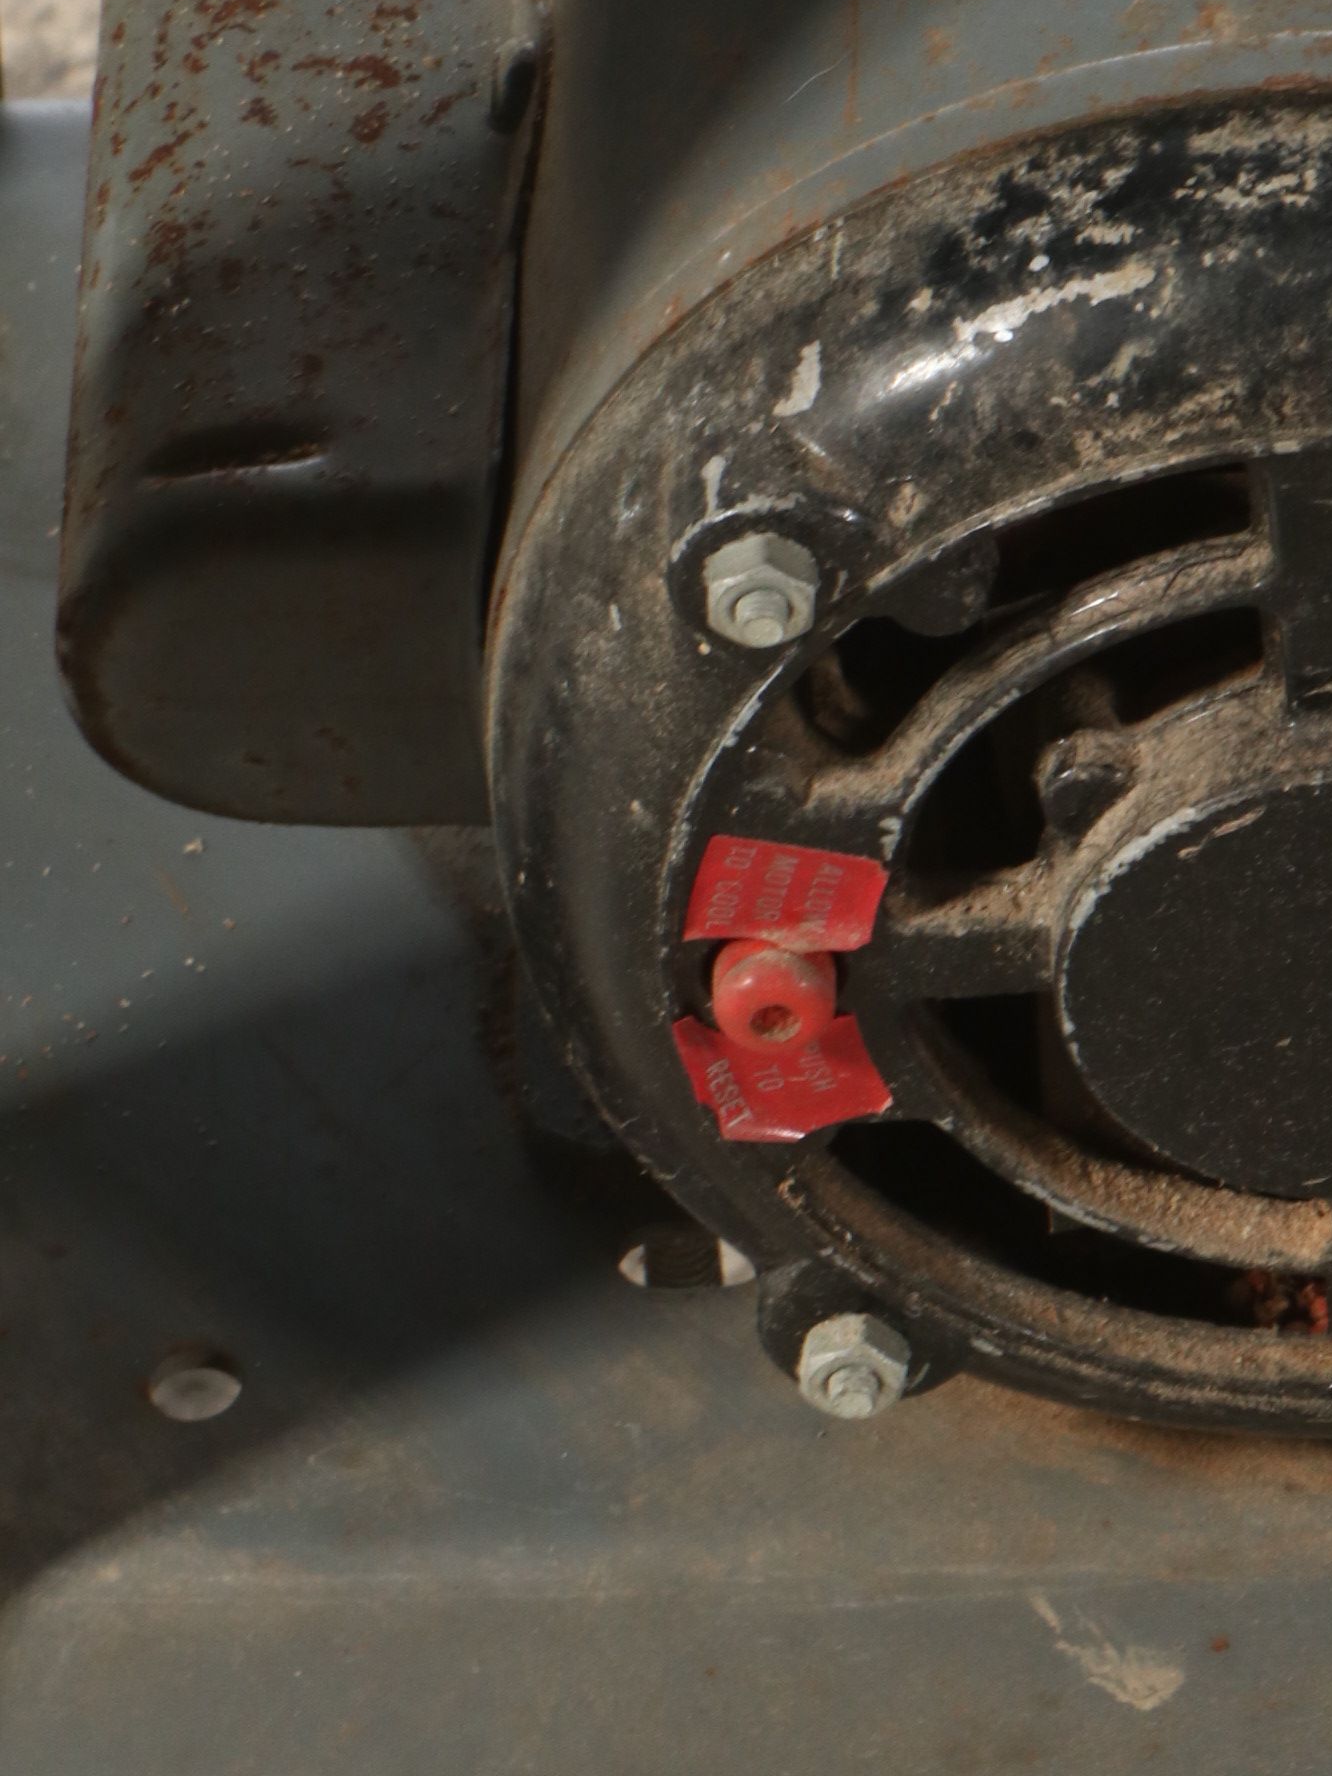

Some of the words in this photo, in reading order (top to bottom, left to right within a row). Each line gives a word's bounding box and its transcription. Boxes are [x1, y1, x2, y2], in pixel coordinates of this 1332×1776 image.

[723, 846, 757, 870] TO
[704, 879, 744, 931] COOL
[753, 853, 798, 922] MOTOR
[705, 1058, 753, 1129] RESET
[753, 1064, 785, 1093] TO
